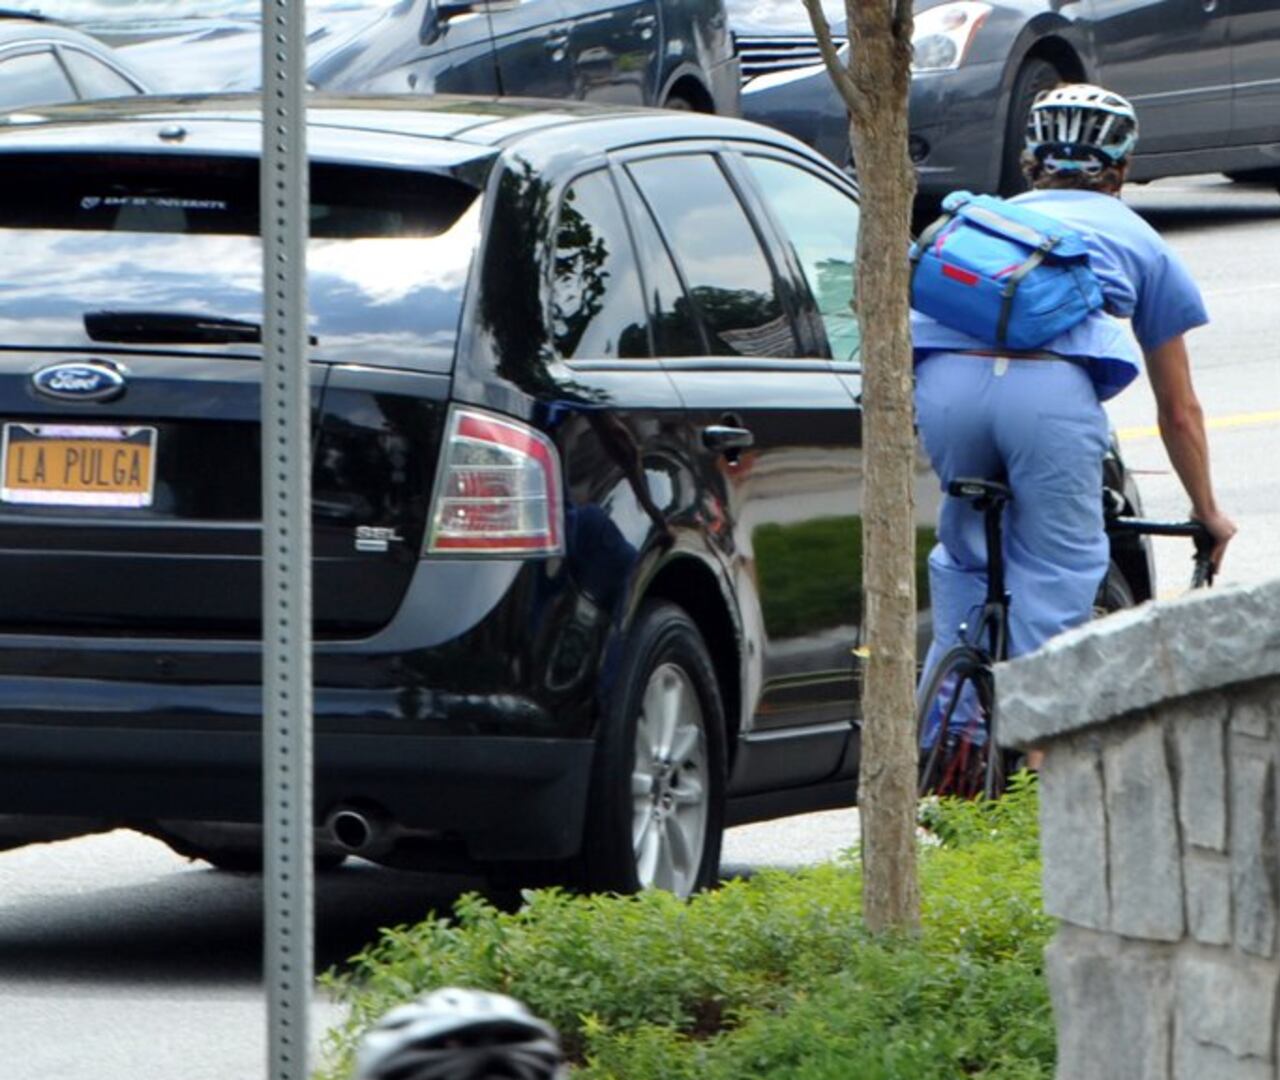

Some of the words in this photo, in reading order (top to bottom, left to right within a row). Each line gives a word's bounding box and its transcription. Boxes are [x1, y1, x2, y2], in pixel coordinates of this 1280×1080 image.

[50, 369, 100, 390] Ford
[17, 447, 46, 484] LA
[63, 448, 142, 487] PULGA
